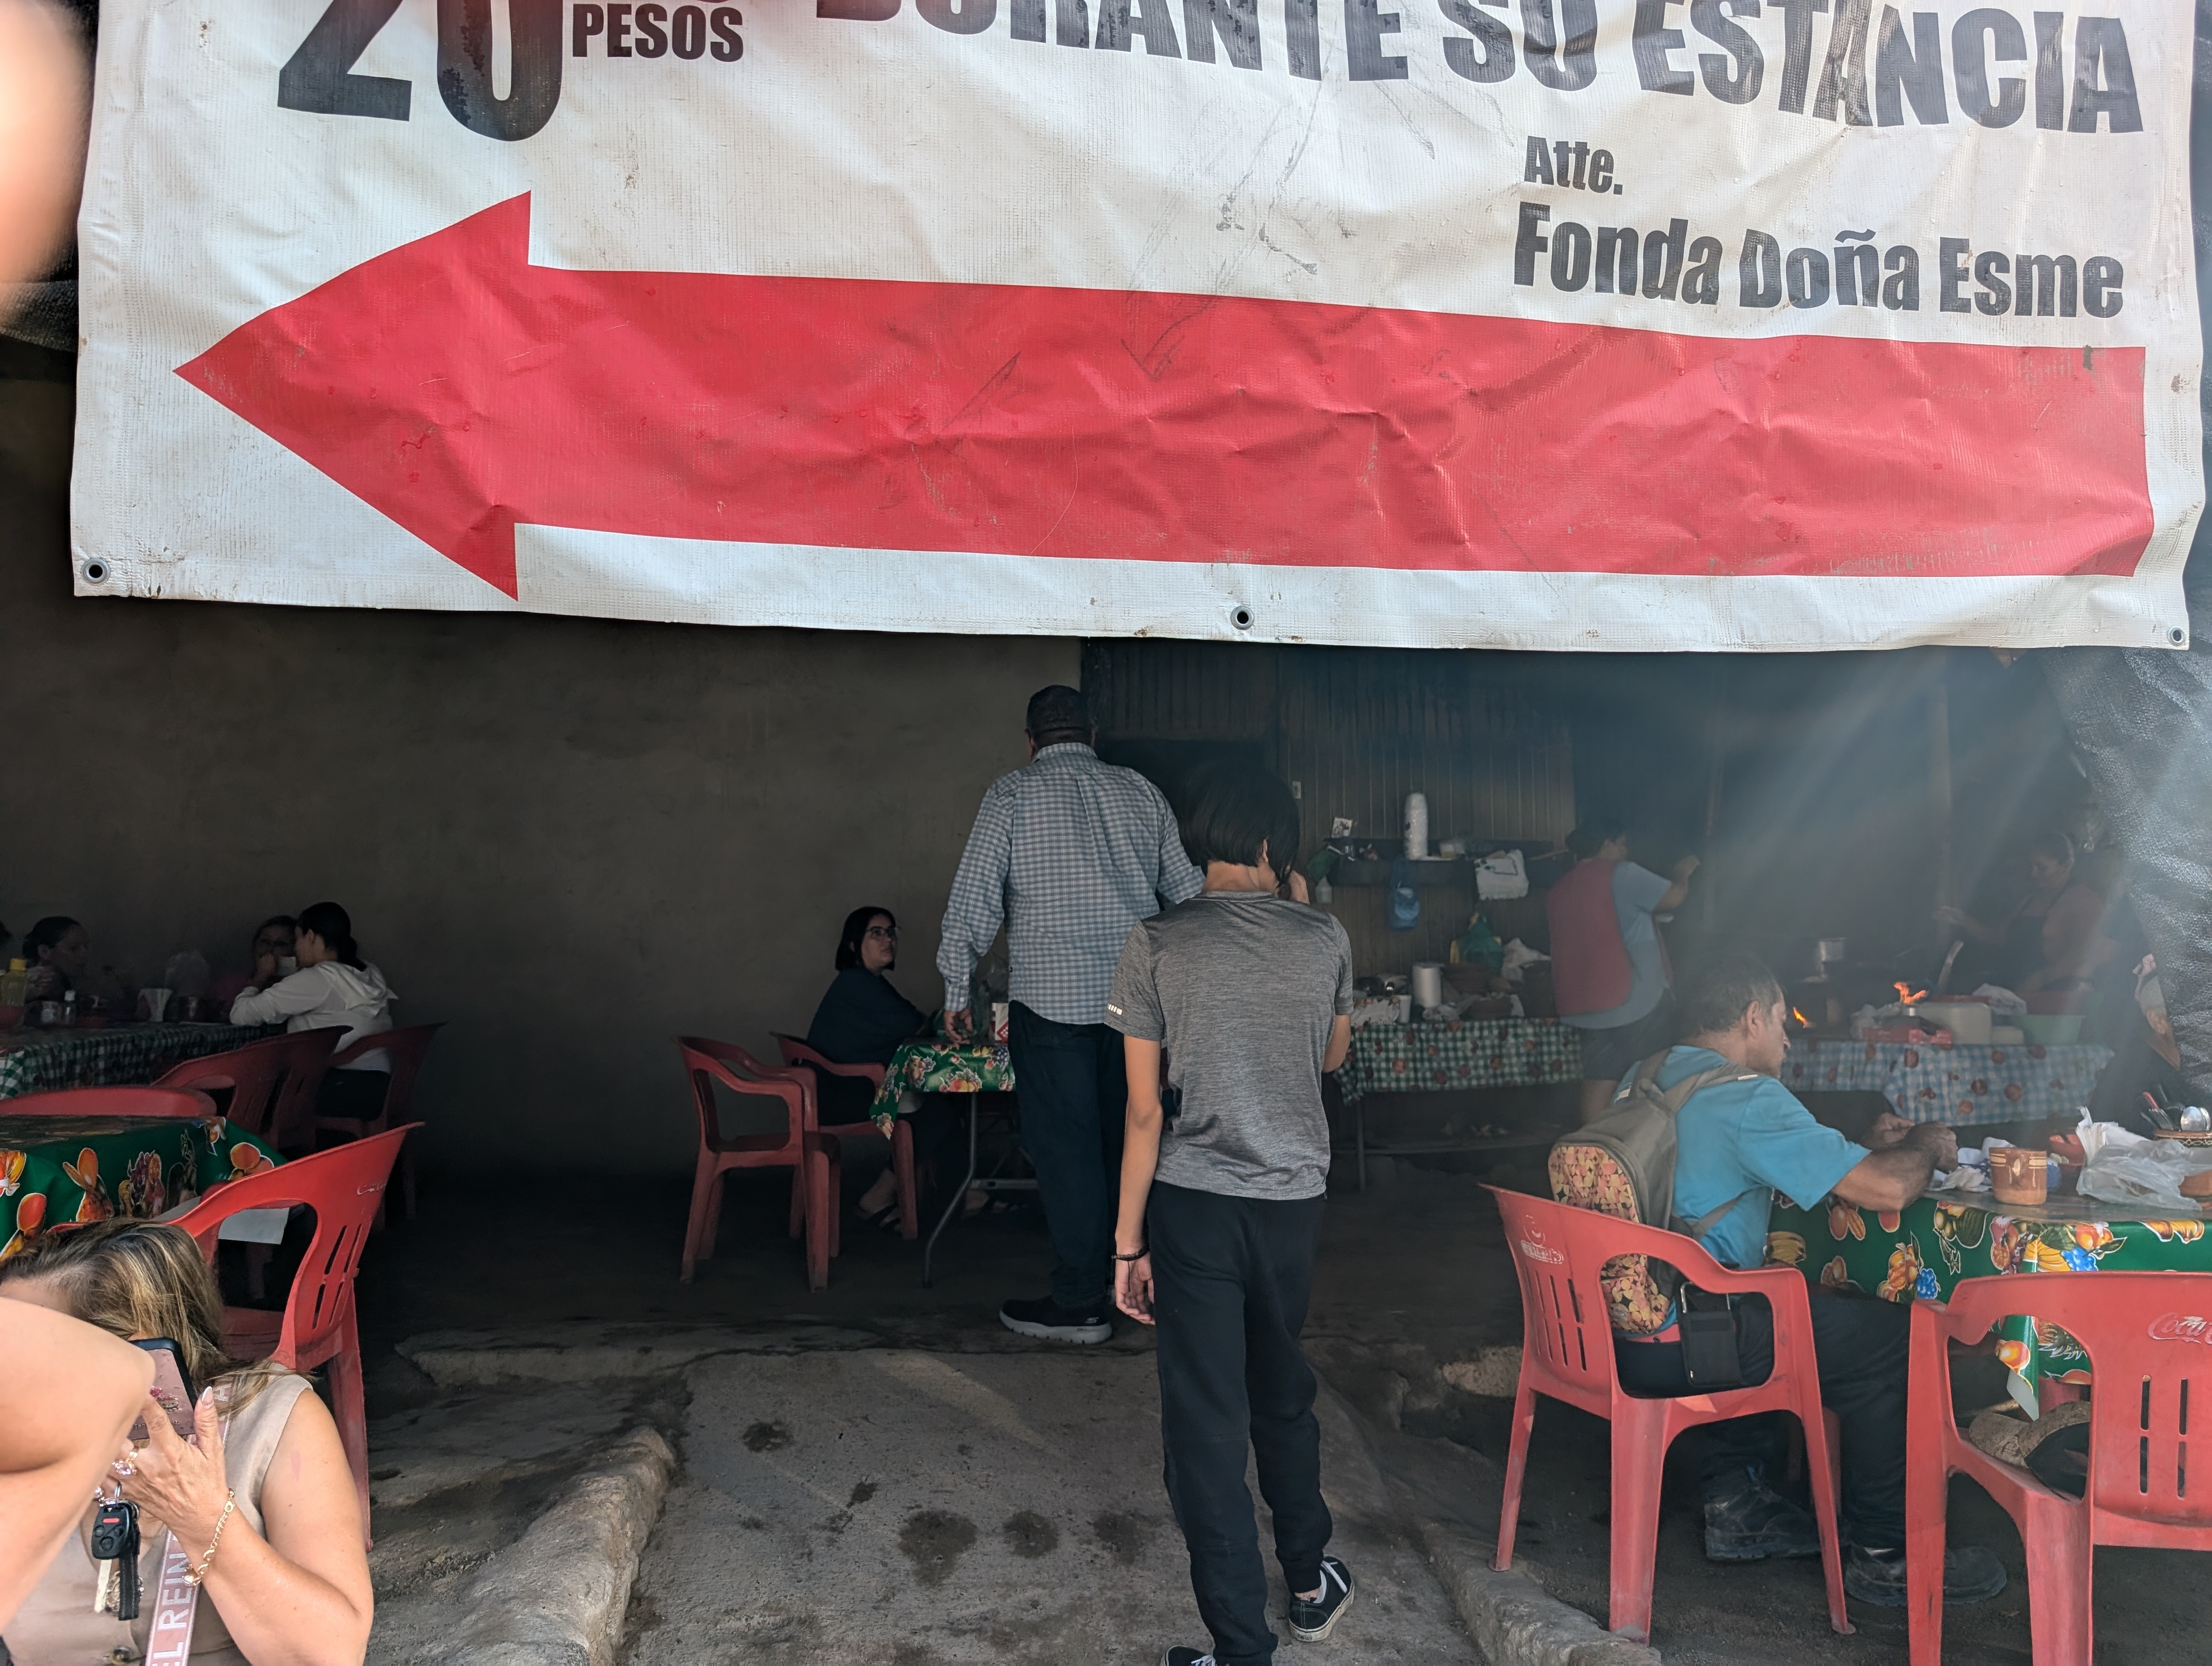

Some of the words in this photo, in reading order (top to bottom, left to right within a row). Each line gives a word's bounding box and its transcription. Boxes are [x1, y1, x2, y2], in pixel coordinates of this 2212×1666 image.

[278, 0, 563, 141] 20
[573, 3, 743, 62] PESOS
[1439, 0, 1597, 91] SU
[1632, 0, 2143, 133] ESTANCIA
[1524, 136, 1623, 195] Atte.
[1514, 202, 1723, 305] Fonda
[1739, 228, 1920, 312] Doña
[1939, 237, 2124, 318] Esme
[158, 1535, 193, 1630] REIN
